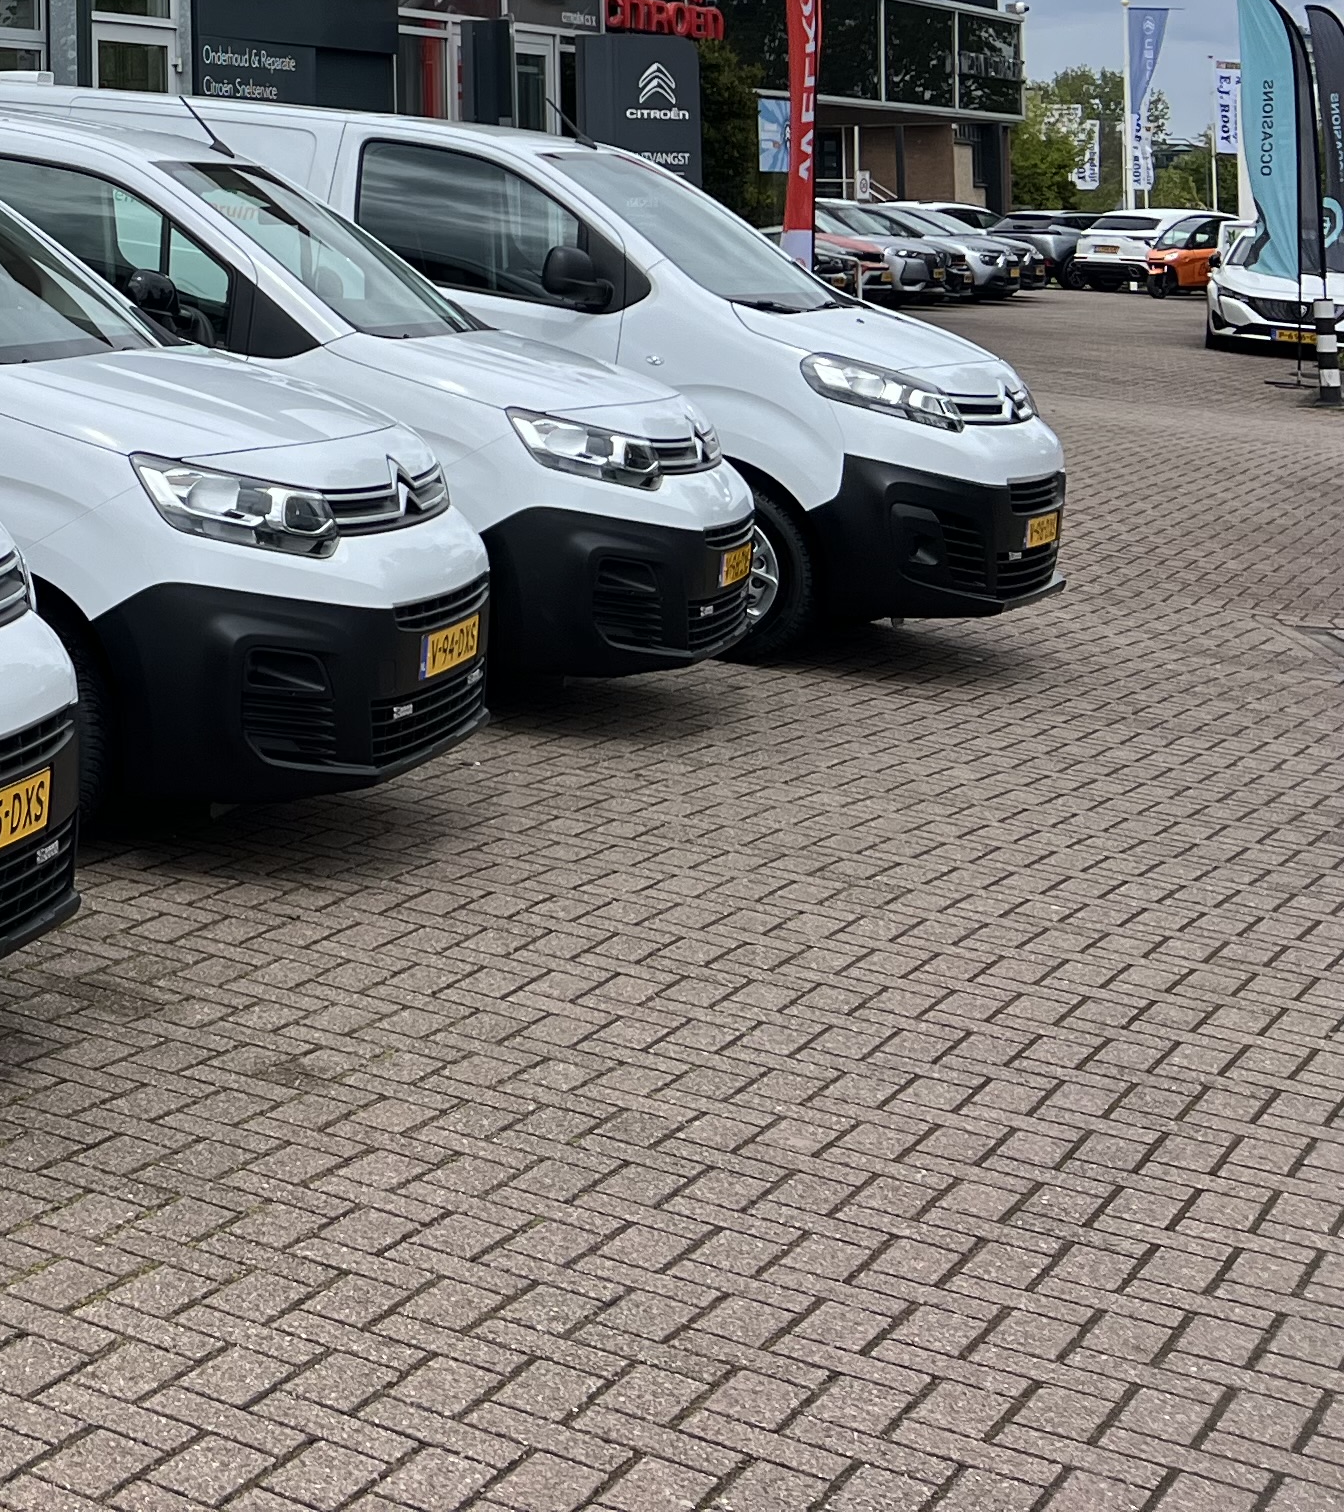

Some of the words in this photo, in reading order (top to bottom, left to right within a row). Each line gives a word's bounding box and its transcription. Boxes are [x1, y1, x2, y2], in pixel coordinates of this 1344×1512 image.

[202, 45, 249, 67] Onderhoud
[251, 49, 260, 68] &
[260, 50, 296, 74] Reparatie
[235, 78, 278, 99] Snelservice
[431, 621, 476, 670] V-94-DXS
